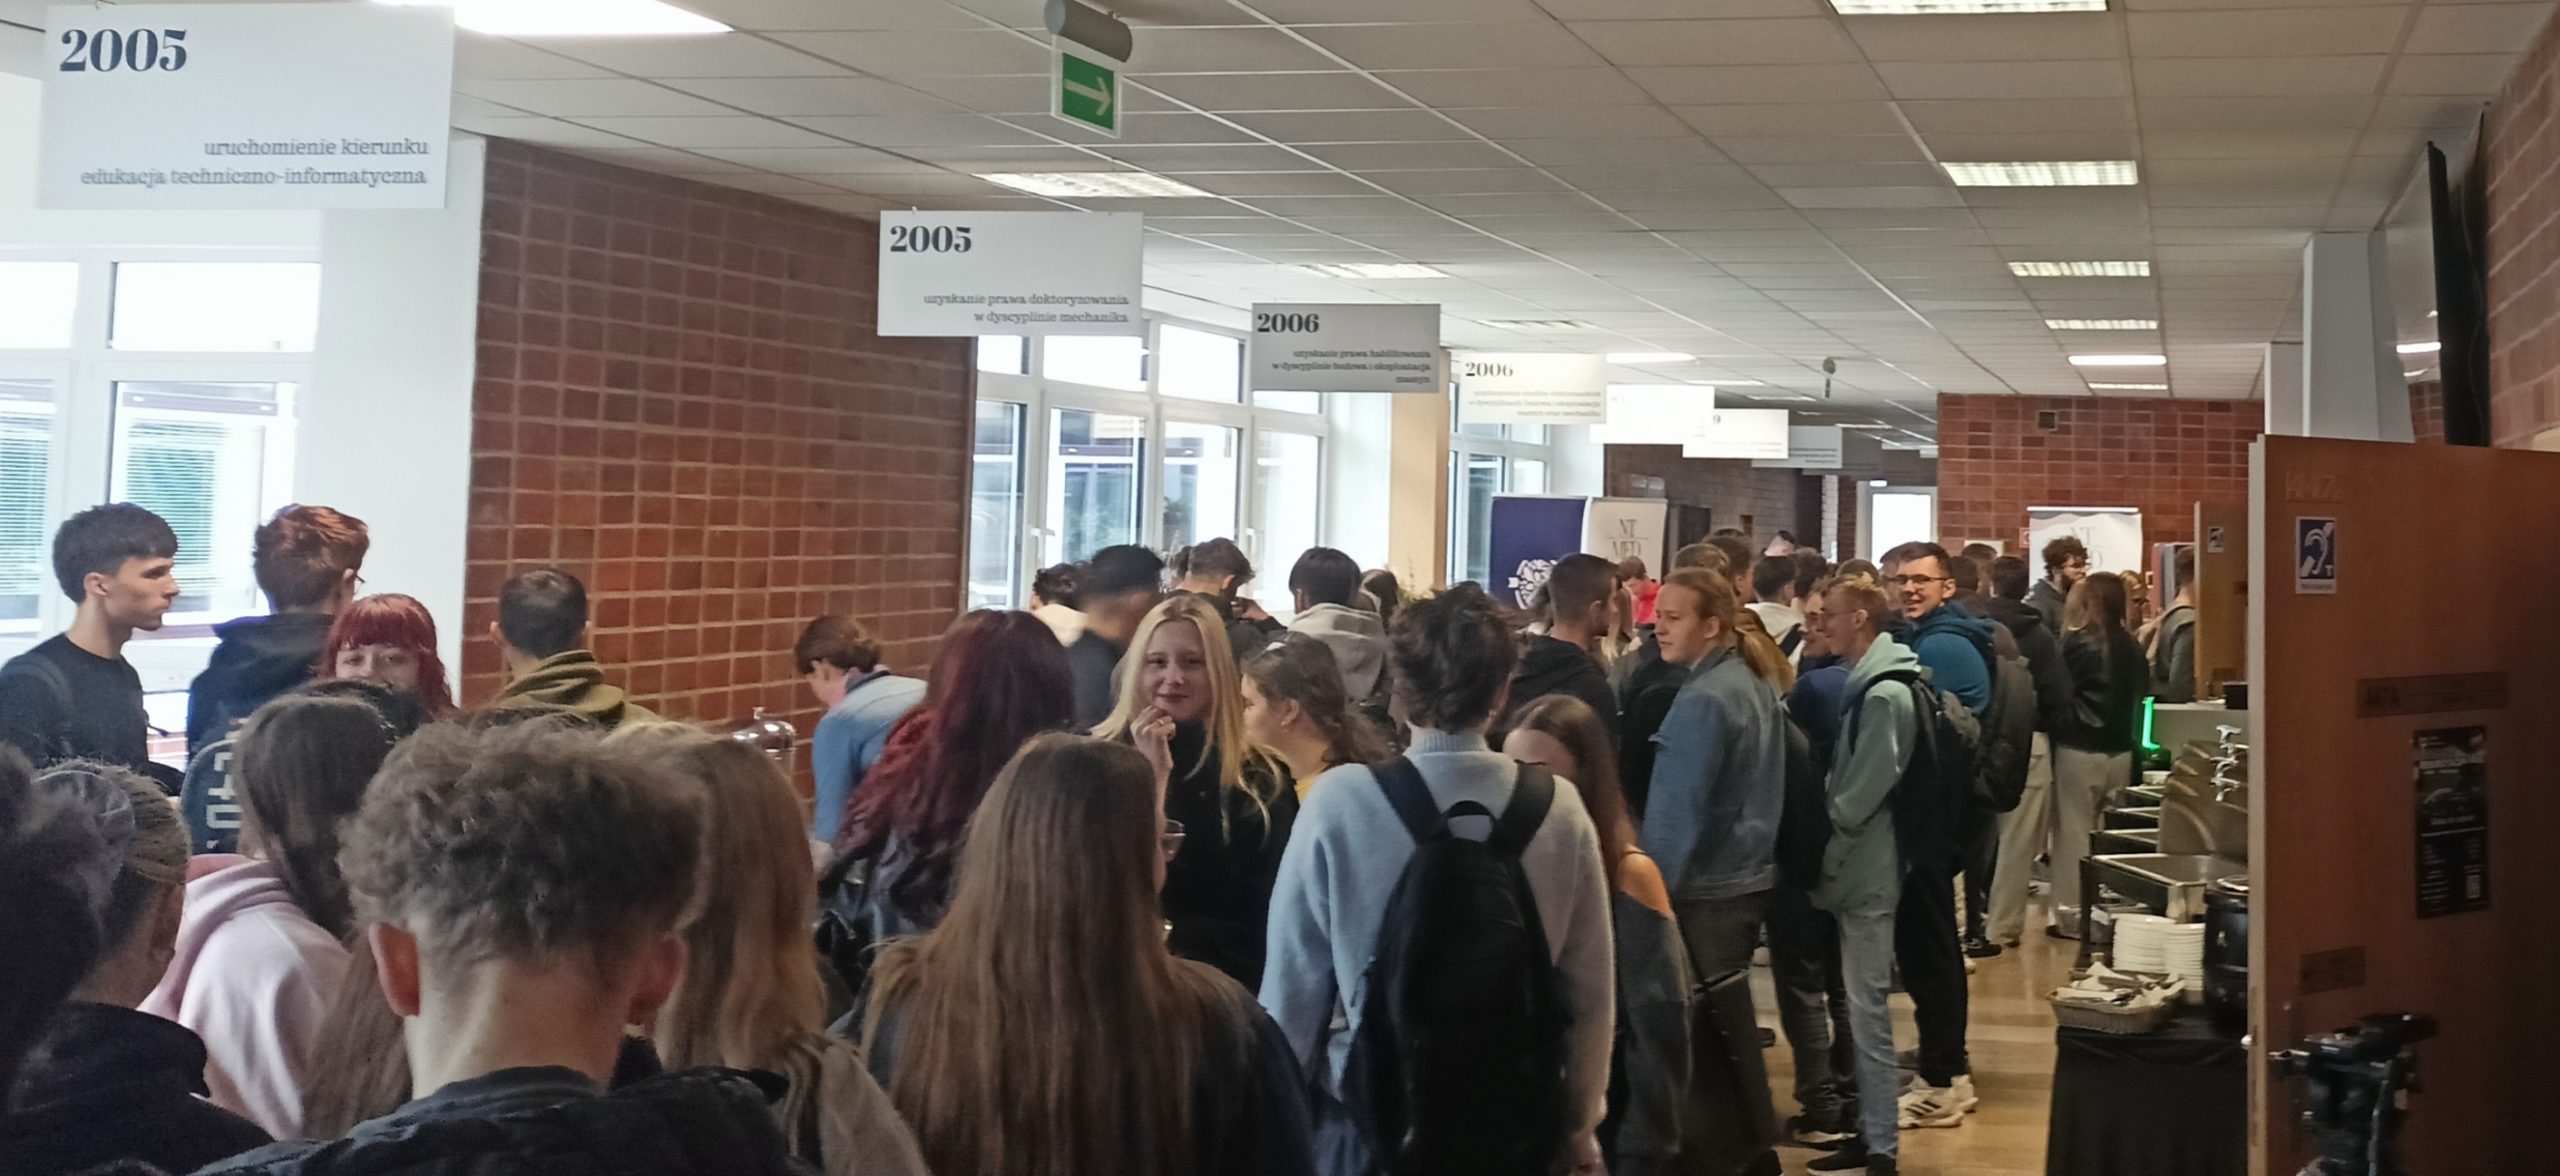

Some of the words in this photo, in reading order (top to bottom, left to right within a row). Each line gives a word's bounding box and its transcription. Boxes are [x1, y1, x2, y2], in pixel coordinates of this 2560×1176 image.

[60, 28, 187, 73] 2005
[204, 138, 337, 156] uruchomienie
[341, 138, 429, 156] kierunku
[81, 168, 166, 189] edukacja
[171, 167, 427, 188] techniczno-informatyczna
[889, 225, 972, 253] 2005
[924, 293, 986, 306] uzyskanie
[988, 295, 1027, 307] prawa
[1029, 293, 1130, 307] doktoryzowania
[974, 312, 984, 322] w
[987, 311, 1057, 325] dyscyplinie
[1060, 311, 1129, 323] mechanika
[1257, 312, 1320, 333] 2006
[1465, 362, 1514, 377] 2006
